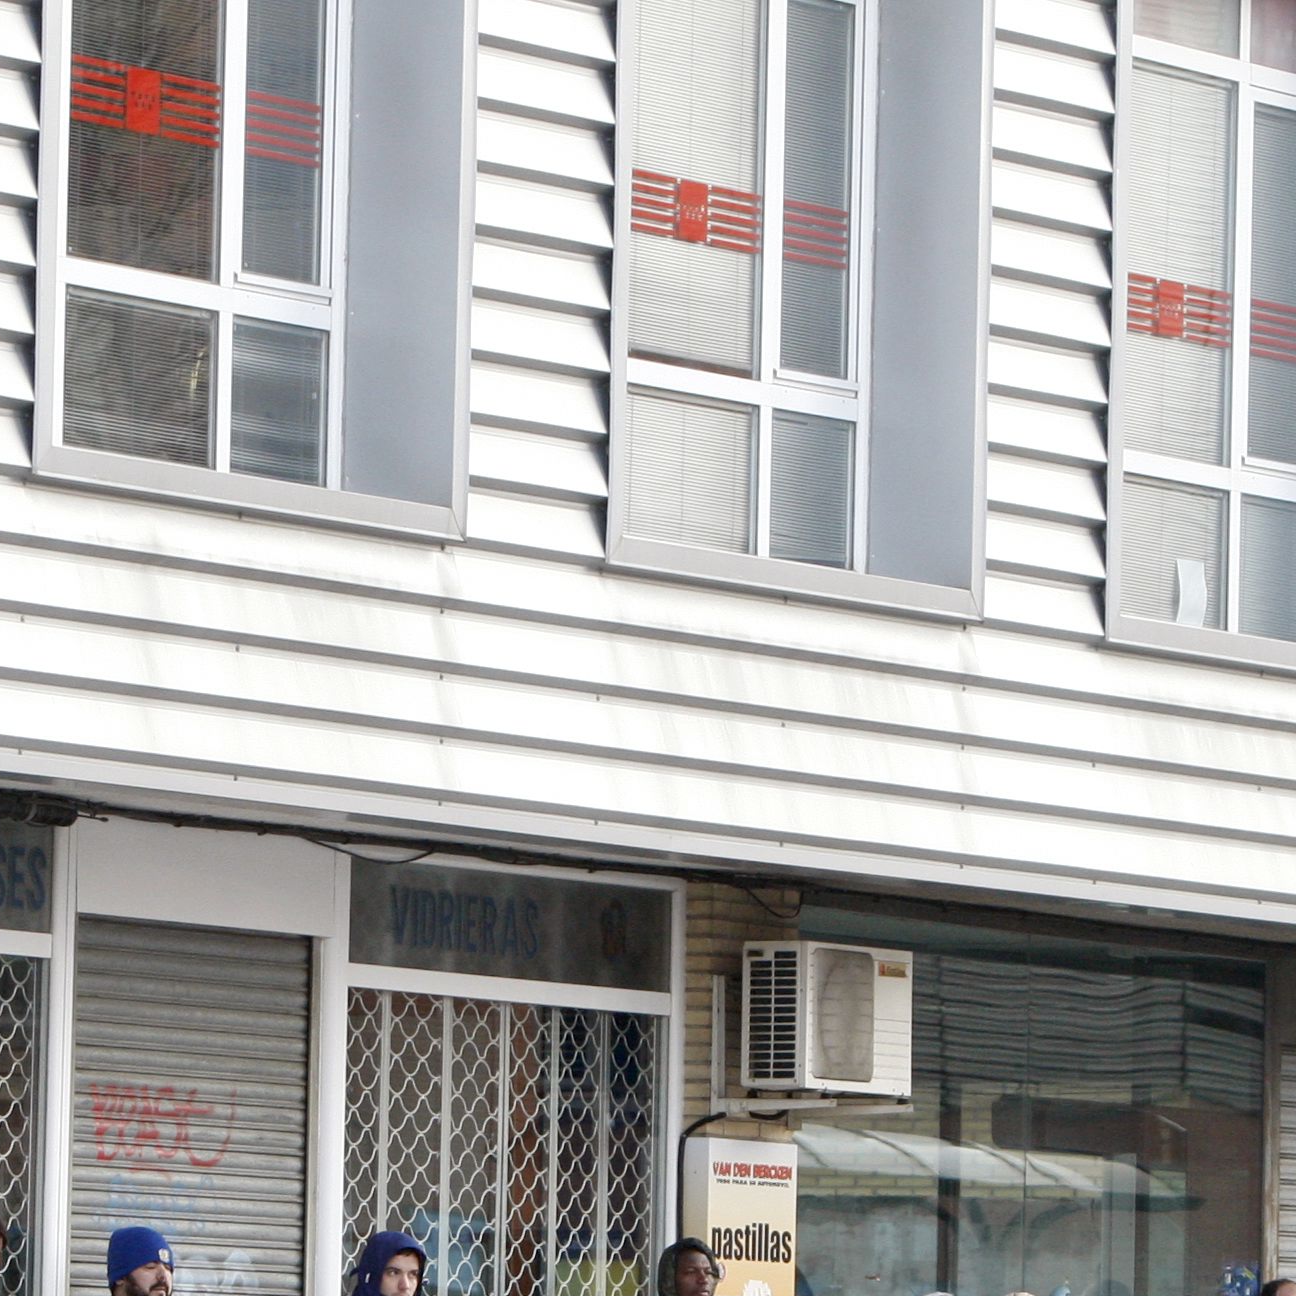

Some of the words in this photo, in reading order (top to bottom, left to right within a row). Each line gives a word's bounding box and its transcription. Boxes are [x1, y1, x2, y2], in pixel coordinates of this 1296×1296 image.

[390, 884, 540, 960] VIDRIERAS
[713, 1161, 732, 1177] VAN
[733, 1162, 751, 1178] DEN
[753, 1163, 792, 1180] BERCKEN
[712, 1222, 792, 1264] pastillas
